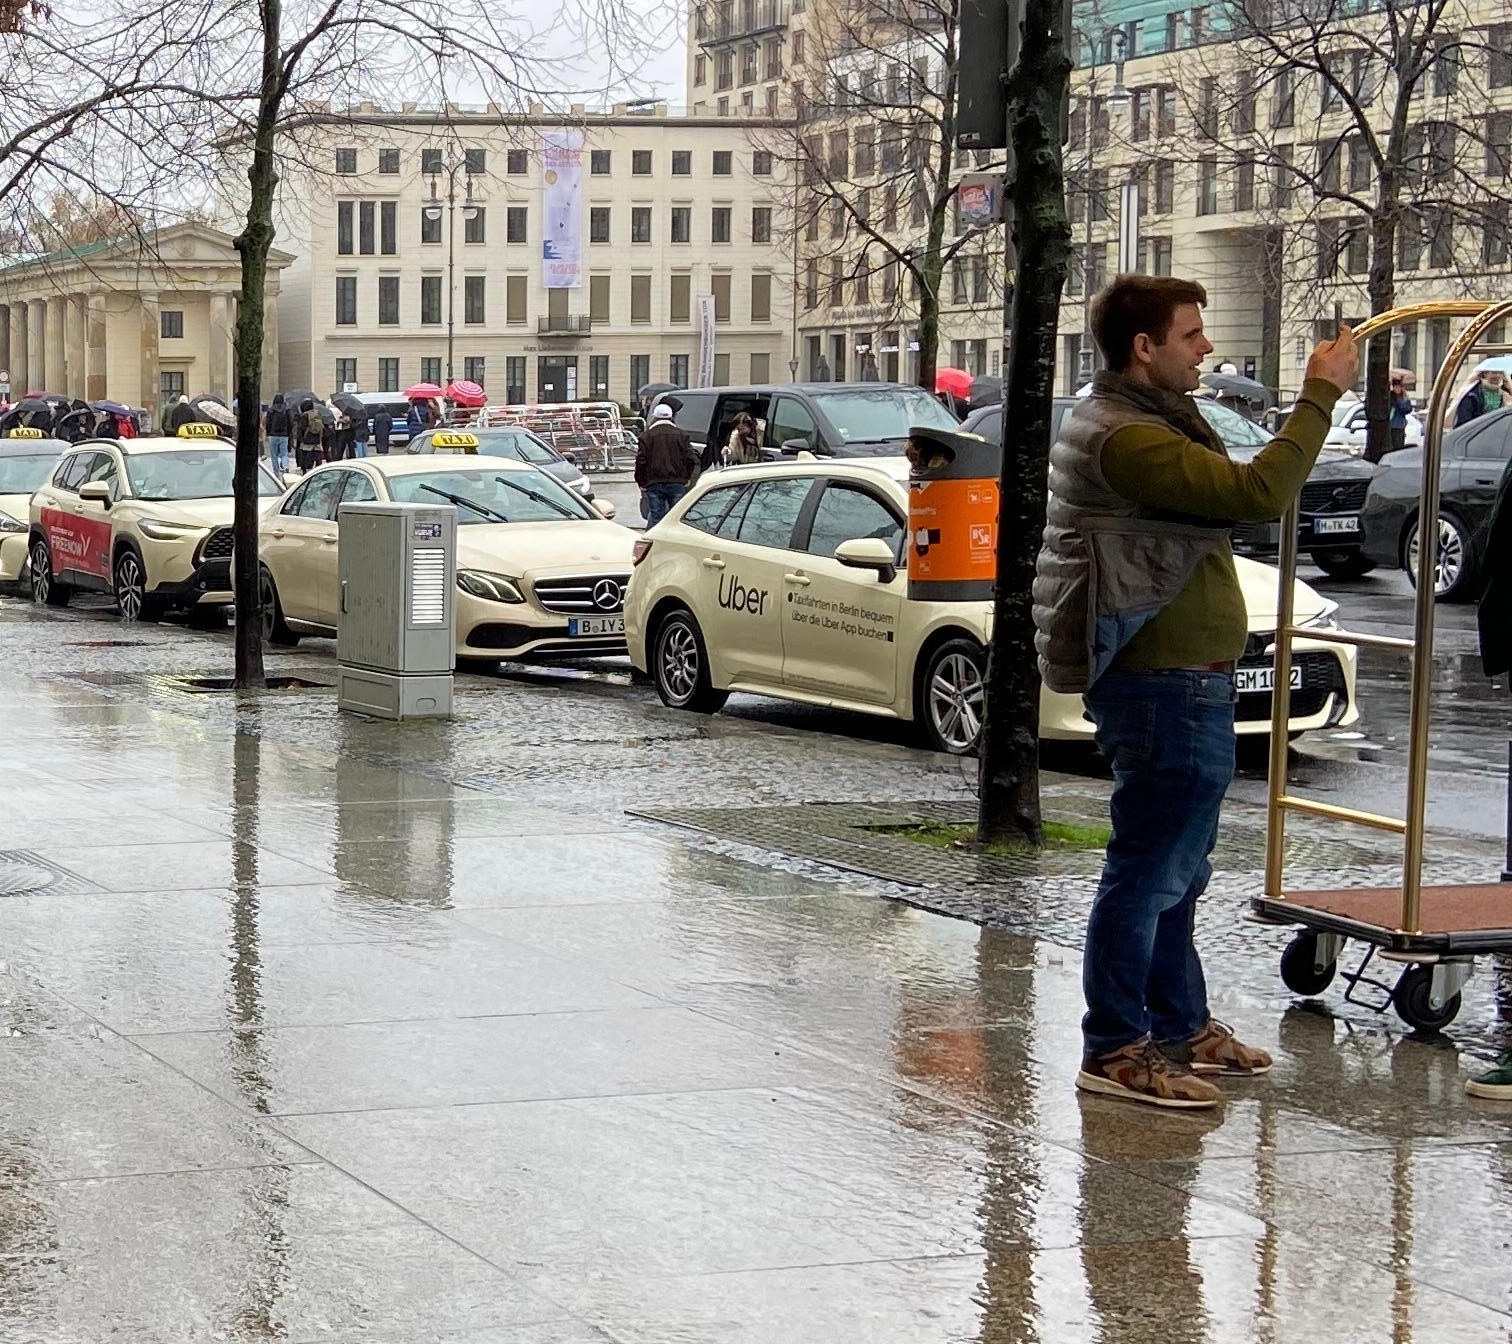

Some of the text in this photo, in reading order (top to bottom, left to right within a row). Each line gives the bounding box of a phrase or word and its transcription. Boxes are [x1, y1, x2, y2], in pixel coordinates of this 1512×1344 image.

[185, 425, 216, 435] TAXI
[441, 435, 474, 445] TAXI
[718, 573, 769, 615] Uber
[839, 602, 860, 617] Berlin
[860, 607, 894, 625] bequem
[582, 620, 591, 633] B
[600, 619, 617, 632] IY
[809, 614, 821, 626] die
[840, 620, 857, 636] App
[858, 624, 888, 641] buchen
